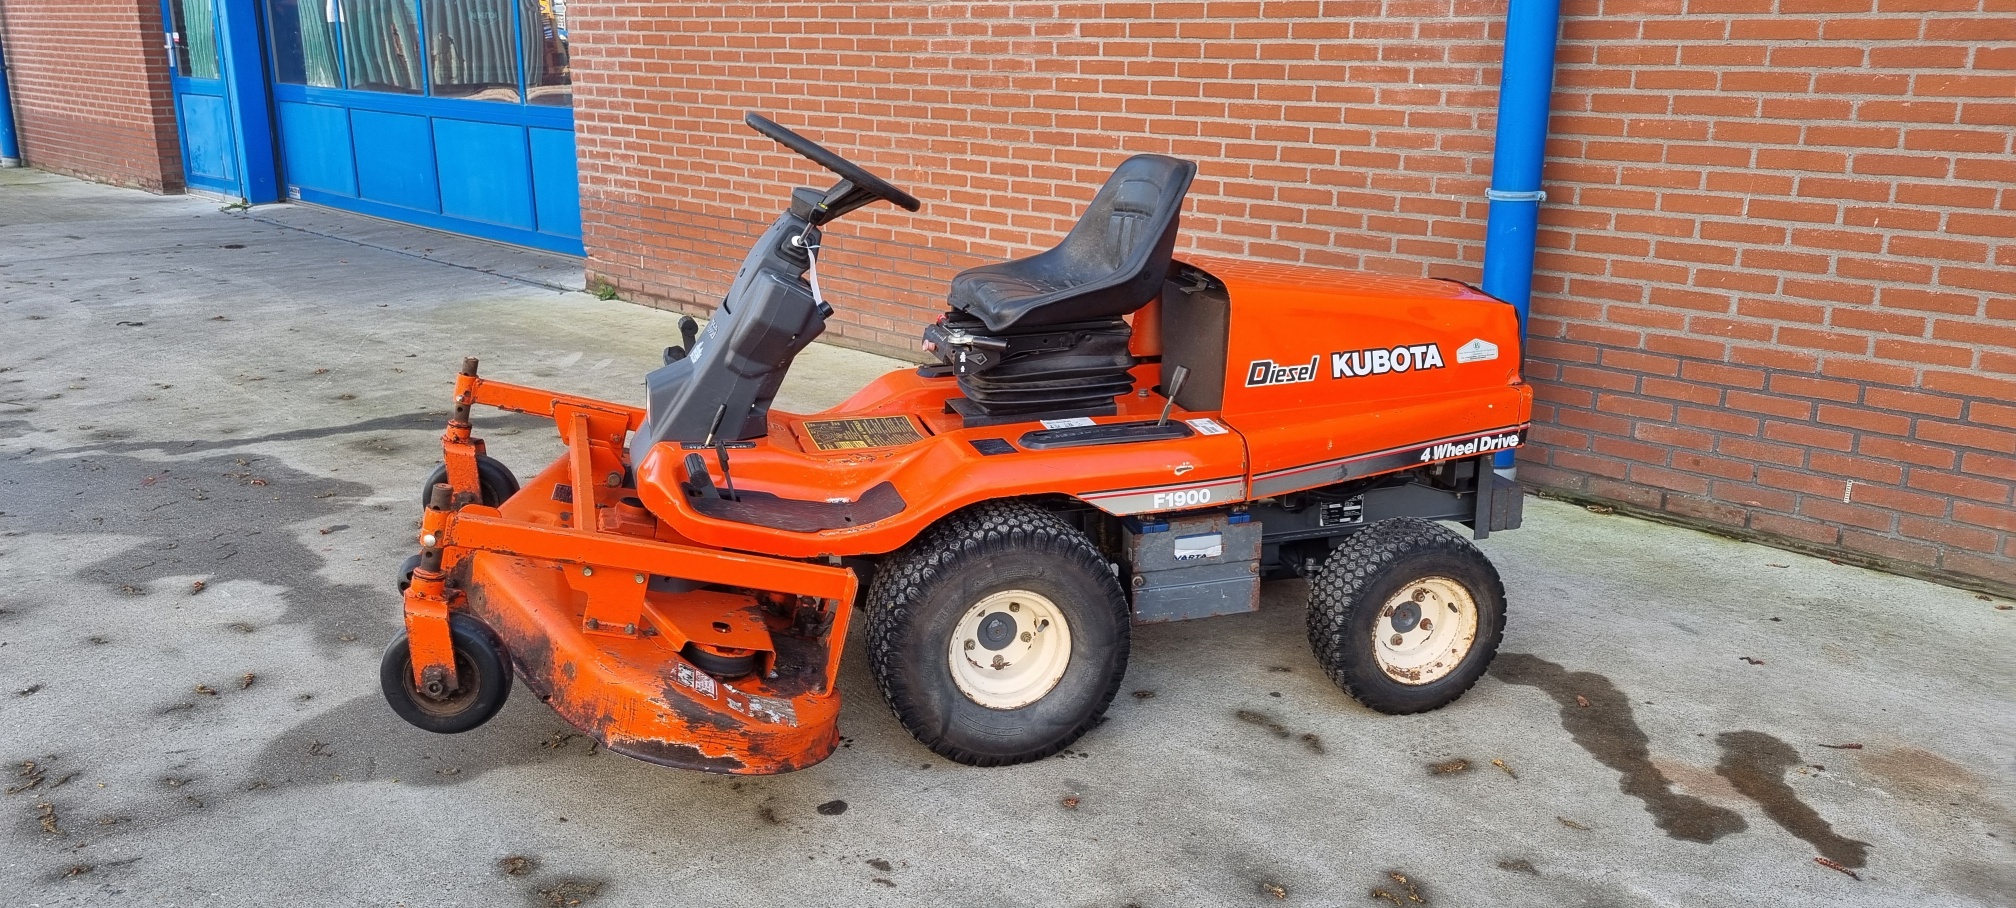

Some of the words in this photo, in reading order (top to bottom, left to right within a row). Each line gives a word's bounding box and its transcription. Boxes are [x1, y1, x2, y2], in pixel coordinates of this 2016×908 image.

[1246, 355, 1319, 386] Diesel
[1331, 342, 1444, 379] KUBOTA
[1420, 447, 1431, 462] 4
[1433, 438, 1478, 460] Wheel
[1479, 434, 1520, 452] Drive
[1153, 488, 1211, 509] F1900
